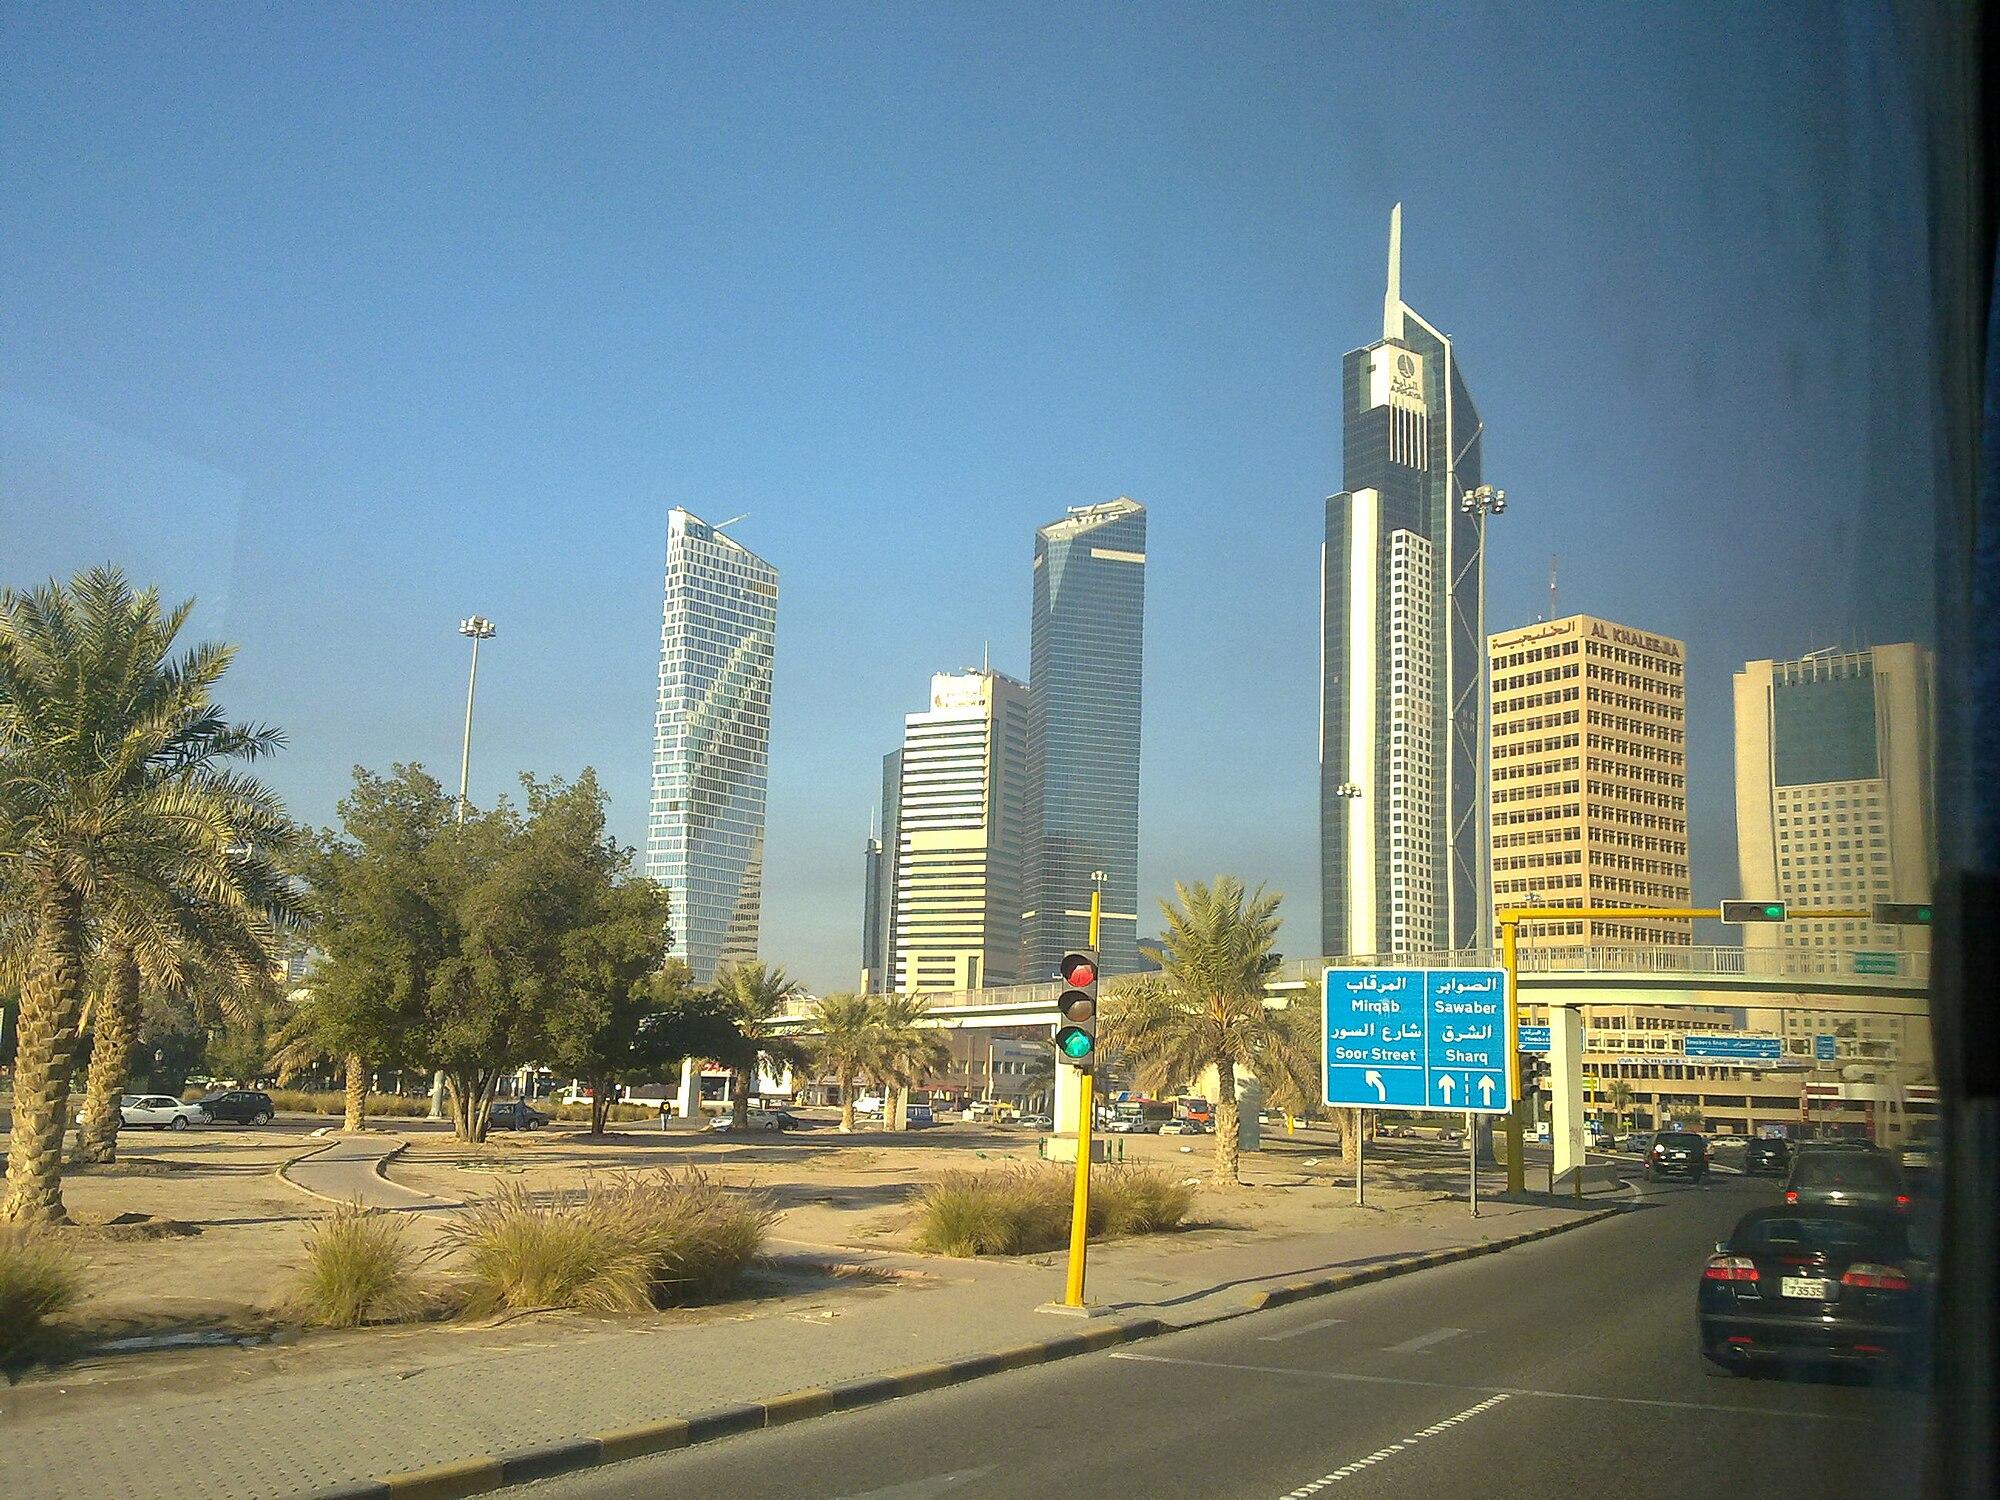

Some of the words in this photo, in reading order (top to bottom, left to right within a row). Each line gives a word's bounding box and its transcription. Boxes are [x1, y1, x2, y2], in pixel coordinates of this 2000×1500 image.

[1591, 622, 1608, 639] AL
[1346, 974, 1406, 993] المرقاب
[1436, 977, 1497, 994] الصوابر
[1351, 1000, 1400, 1015] Mirqab
[1435, 1001, 1497, 1014] Sawaber
[1331, 1023, 1375, 1040] السور
[1382, 1023, 1422, 1042] شارع
[1442, 1024, 1492, 1042] الشرق
[1335, 1047, 1368, 1060] Soor
[1372, 1048, 1416, 1061] Street
[1446, 1049, 1488, 1065] Sharq
